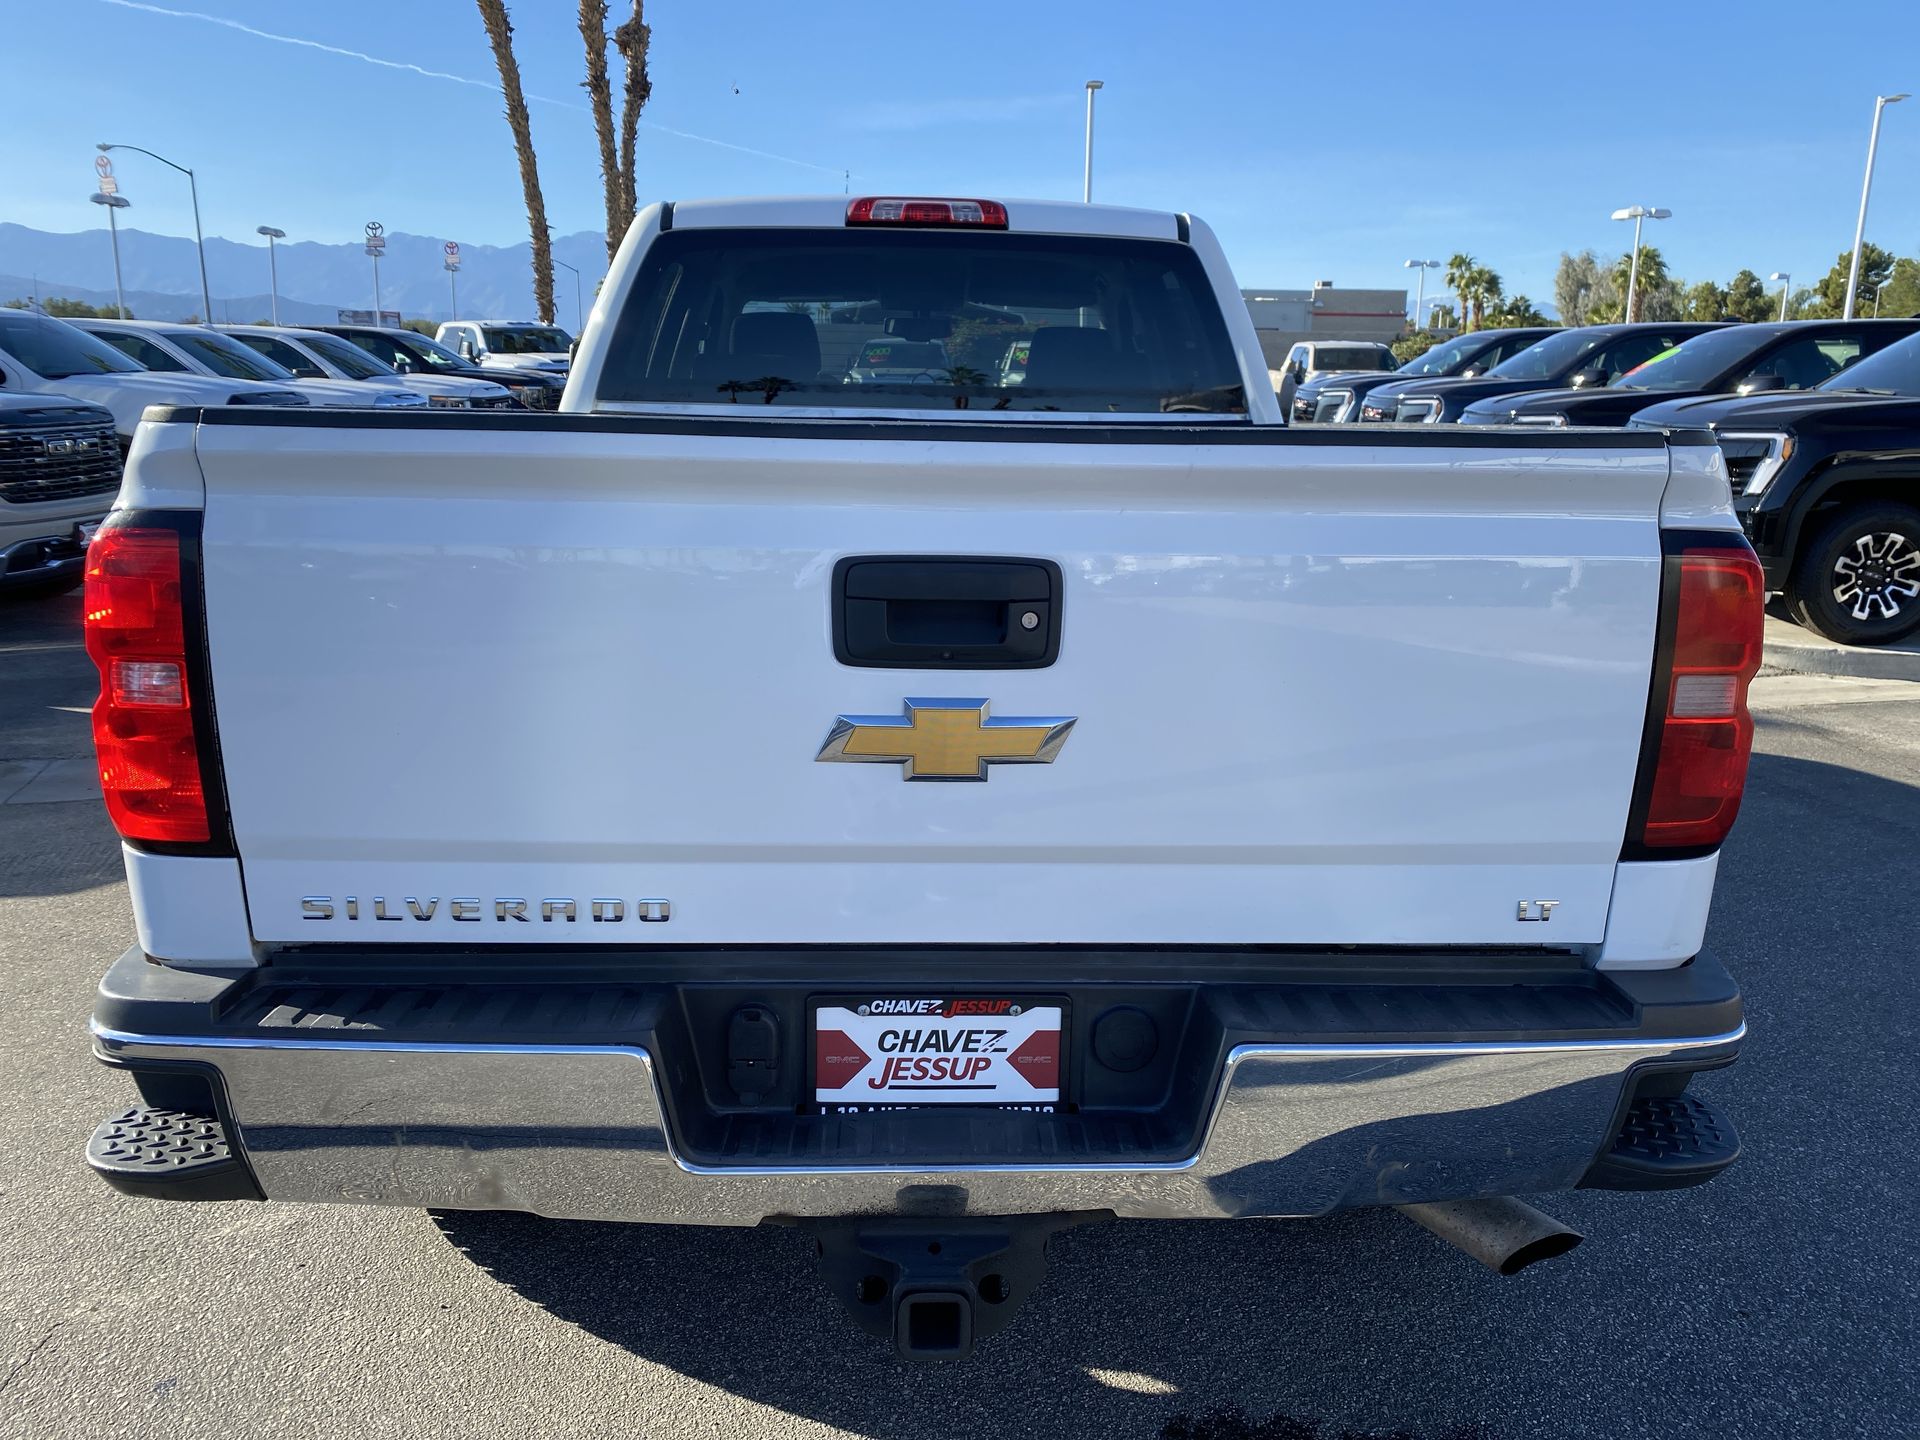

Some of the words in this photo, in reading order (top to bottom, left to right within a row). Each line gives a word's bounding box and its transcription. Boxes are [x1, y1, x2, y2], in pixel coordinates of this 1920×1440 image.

[302, 896, 671, 923] SILVERADO
[1517, 900, 1560, 921] LT
[871, 1000, 943, 1013] CHAVEZ
[943, 1000, 1012, 1018] JESSUP
[877, 1029, 1010, 1053] CHAVEZ
[825, 1056, 860, 1064] GMC
[1017, 1056, 1052, 1064] GMC
[868, 1057, 992, 1090] JESSUP
